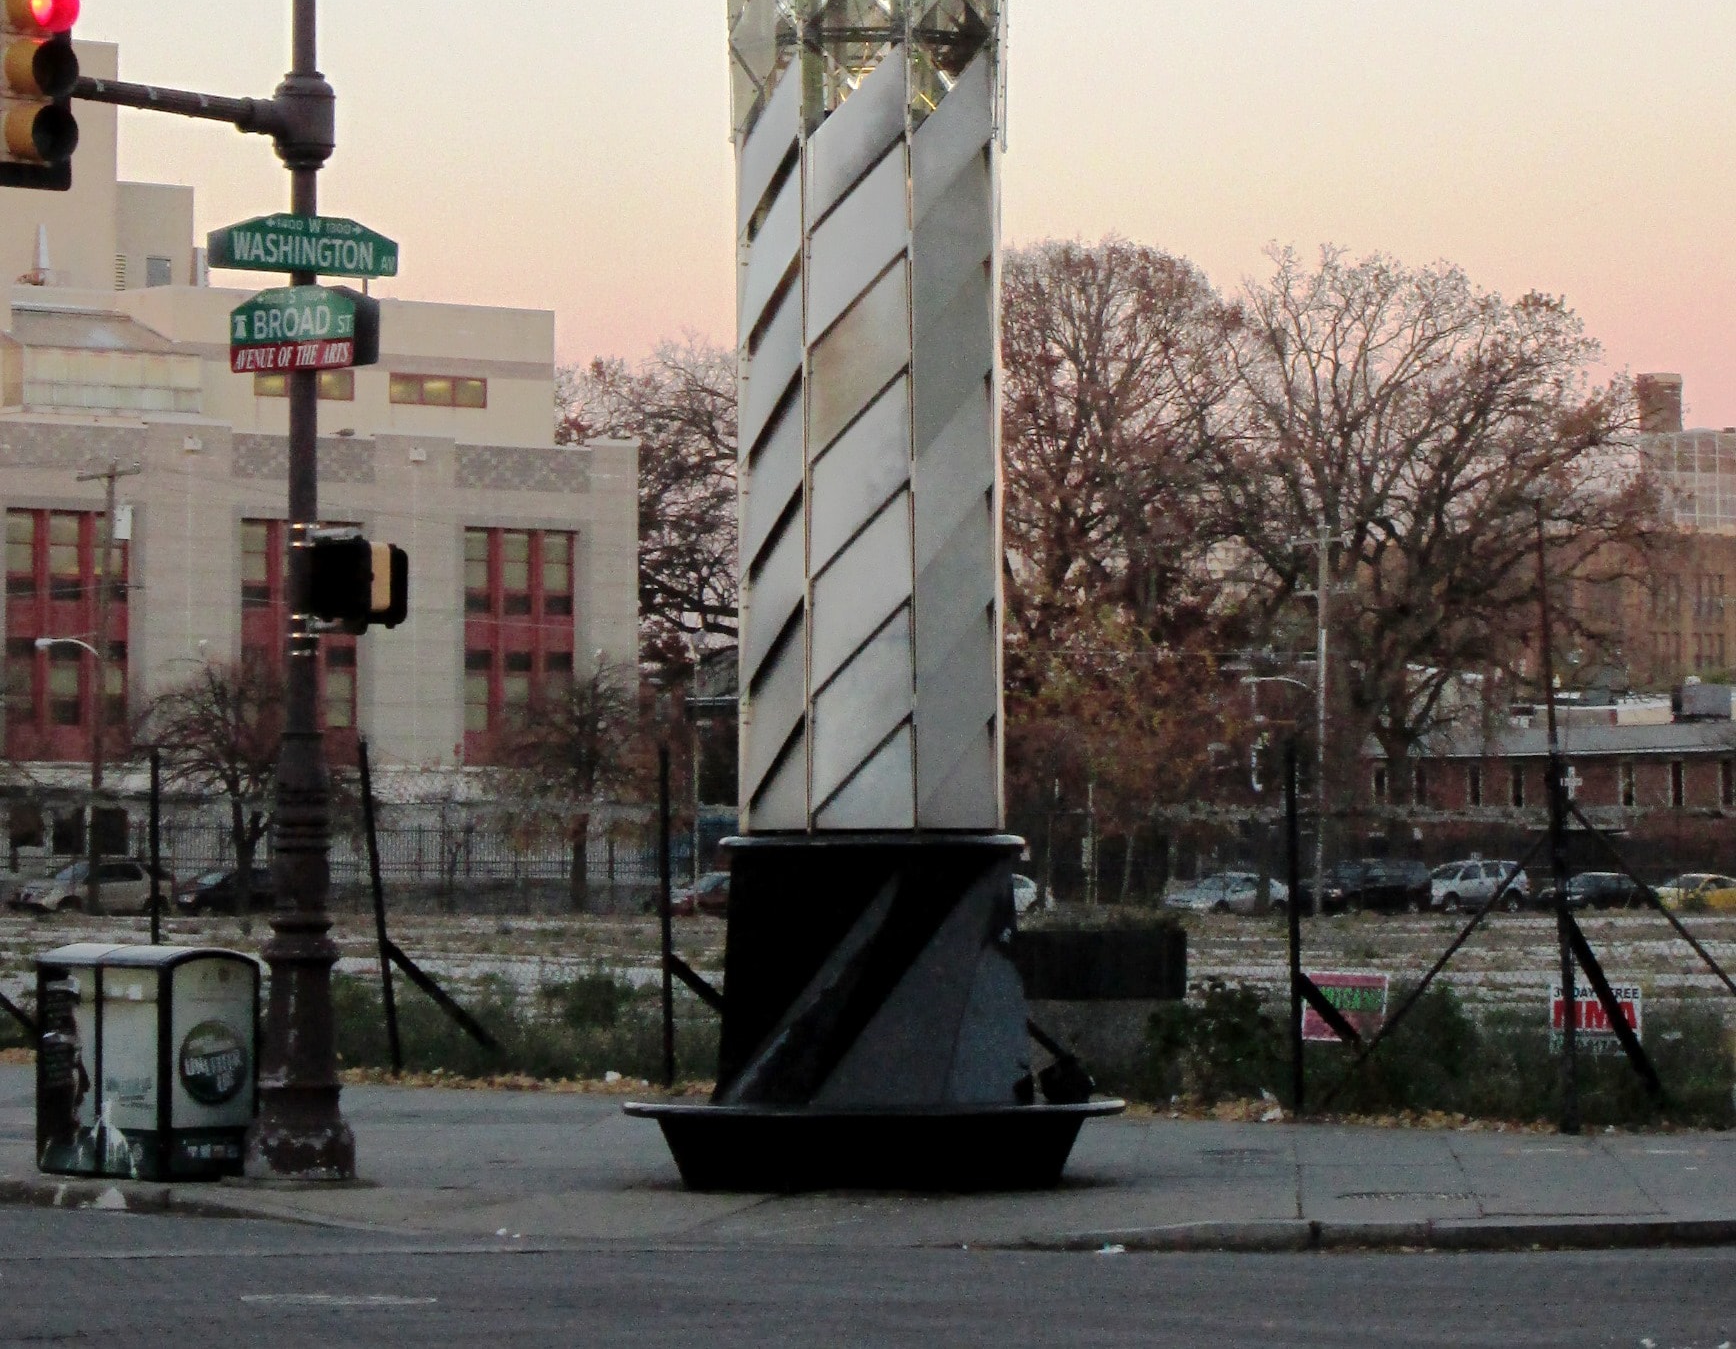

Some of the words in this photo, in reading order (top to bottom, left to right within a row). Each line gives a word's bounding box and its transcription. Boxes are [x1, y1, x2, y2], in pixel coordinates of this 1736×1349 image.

[308, 217, 321, 234] W
[233, 231, 374, 271] WASHINGTON
[254, 306, 330, 339] BROAD
[337, 314, 353, 333] ST
[236, 348, 275, 369] AVENUE
[278, 347, 293, 367] OF
[295, 345, 318, 365] THE
[322, 343, 350, 363] ARTS
